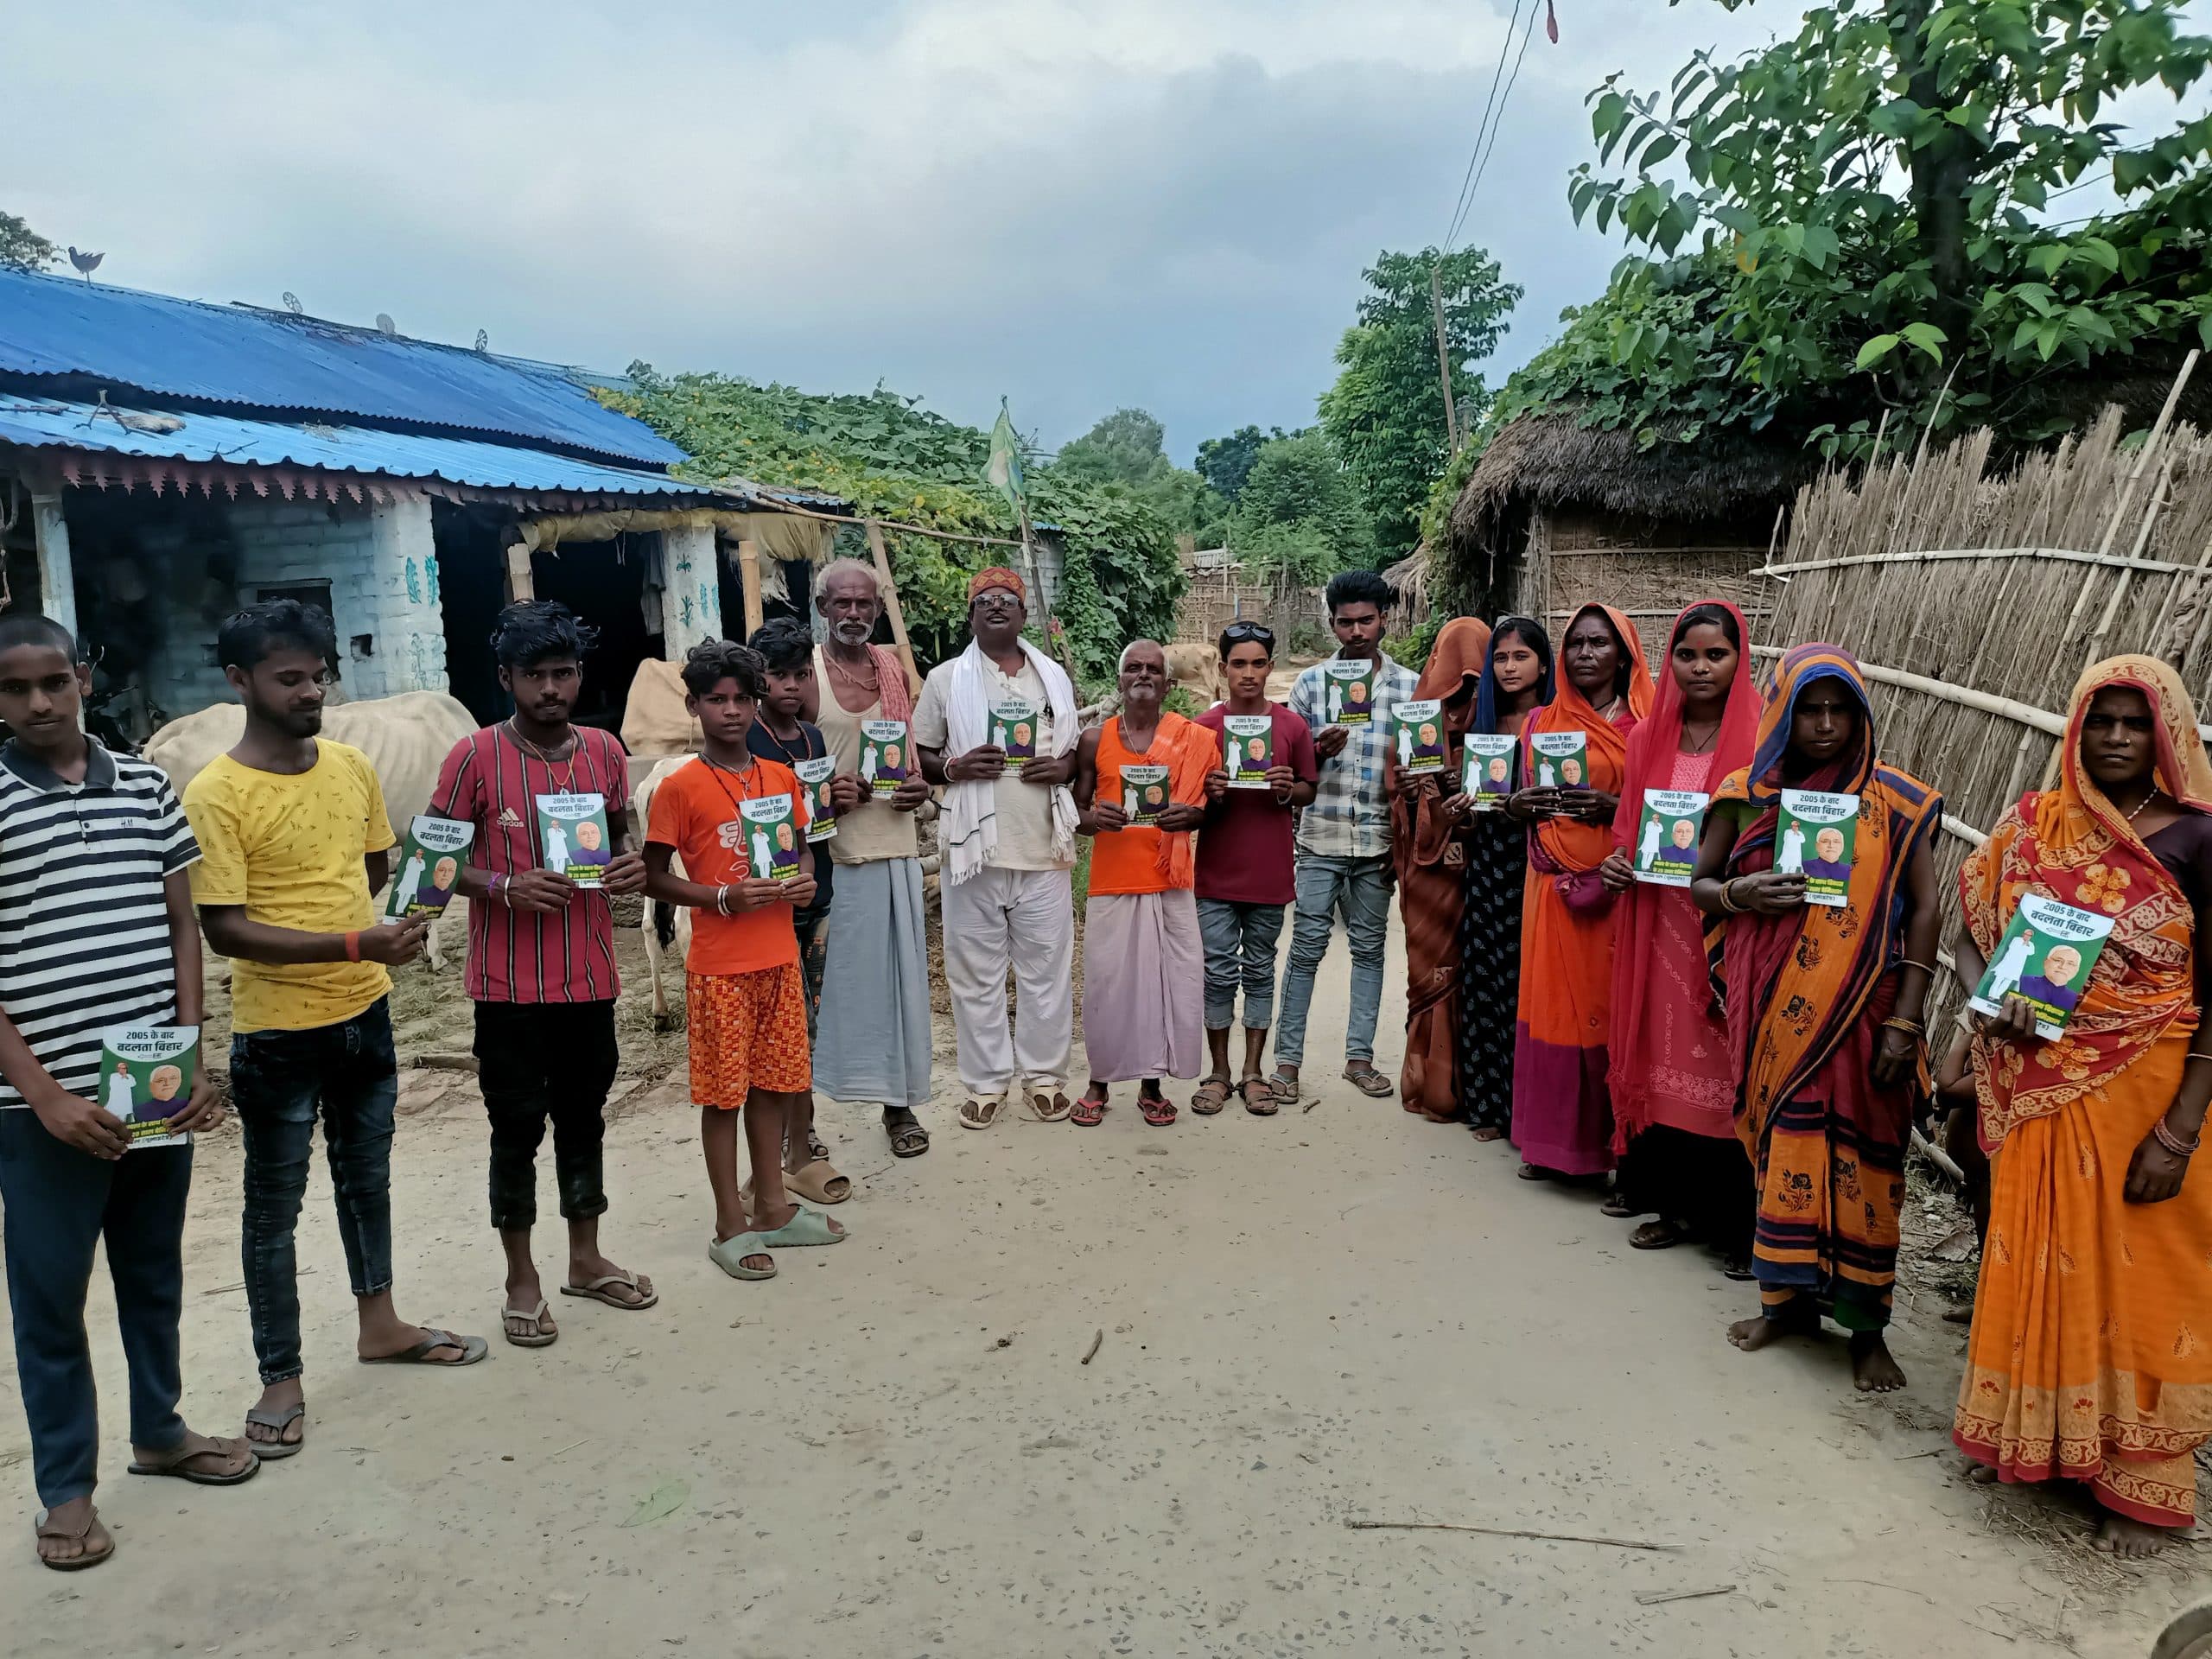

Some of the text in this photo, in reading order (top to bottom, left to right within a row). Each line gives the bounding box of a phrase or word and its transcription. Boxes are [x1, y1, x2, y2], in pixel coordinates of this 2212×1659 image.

[1676, 791, 1682, 800] के
[1819, 795, 1827, 804] के
[1653, 799, 1698, 810] बदलता बिहार
[1791, 804, 1847, 816] बदलता बिहार
[429, 823, 461, 834] 2005 के बाद
[420, 832, 464, 845] बदलता बिहार
[2044, 902, 2091, 923] 2005 के बाद
[2031, 910, 2066, 928] बदलता
[2065, 918, 2095, 938] बिहार
[150, 1030, 159, 1039] के
[117, 1041, 183, 1052] बदलता बिहार
